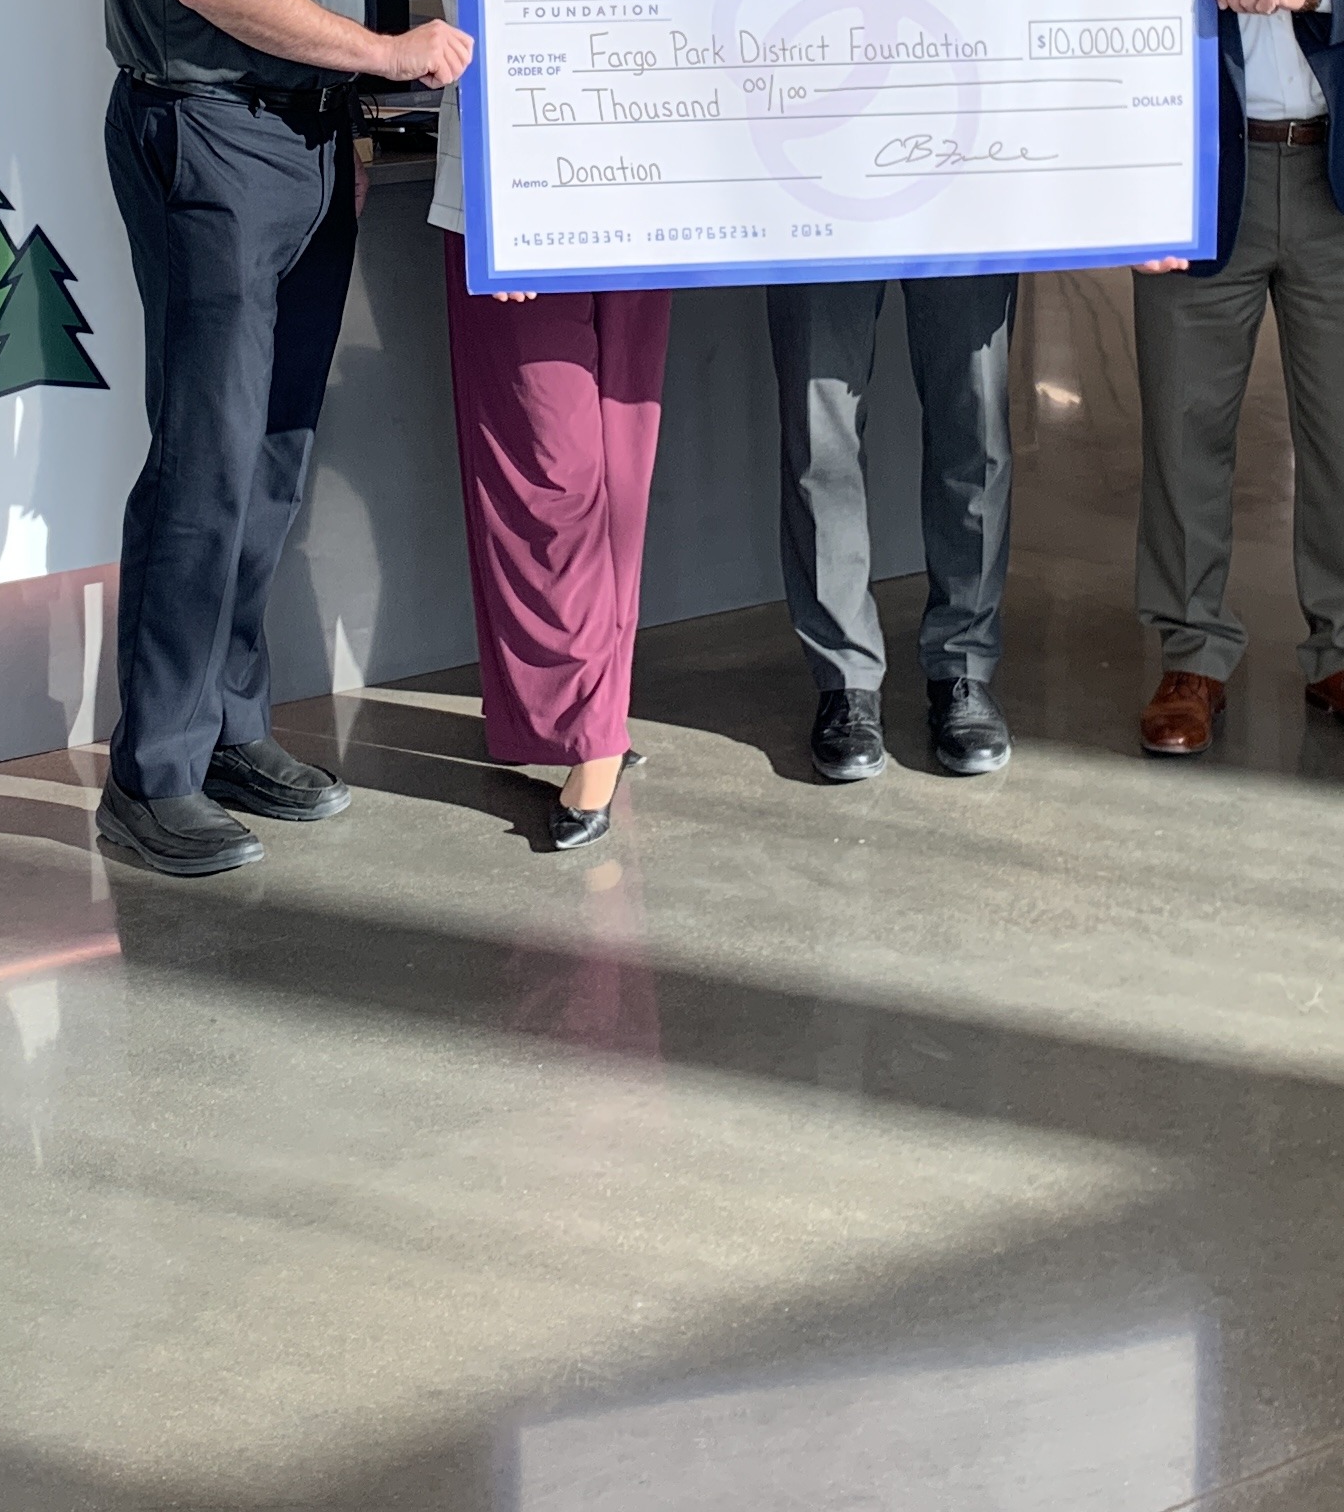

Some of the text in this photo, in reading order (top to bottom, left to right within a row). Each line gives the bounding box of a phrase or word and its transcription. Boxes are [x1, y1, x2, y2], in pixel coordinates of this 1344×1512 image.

[522, 4, 661, 19] FOUNDATION
[506, 53, 567, 65] PAY TO THE
[588, 27, 988, 76] Fargo Park District Foundation
[507, 65, 561, 78] ORDER OF
[516, 87, 576, 122] Ten
[582, 87, 720, 120] Thousand
[1132, 96, 1184, 108] DOLLARS
[556, 155, 662, 185] Donation
[511, 177, 549, 188] Memo
[790, 223, 835, 239] 2015
